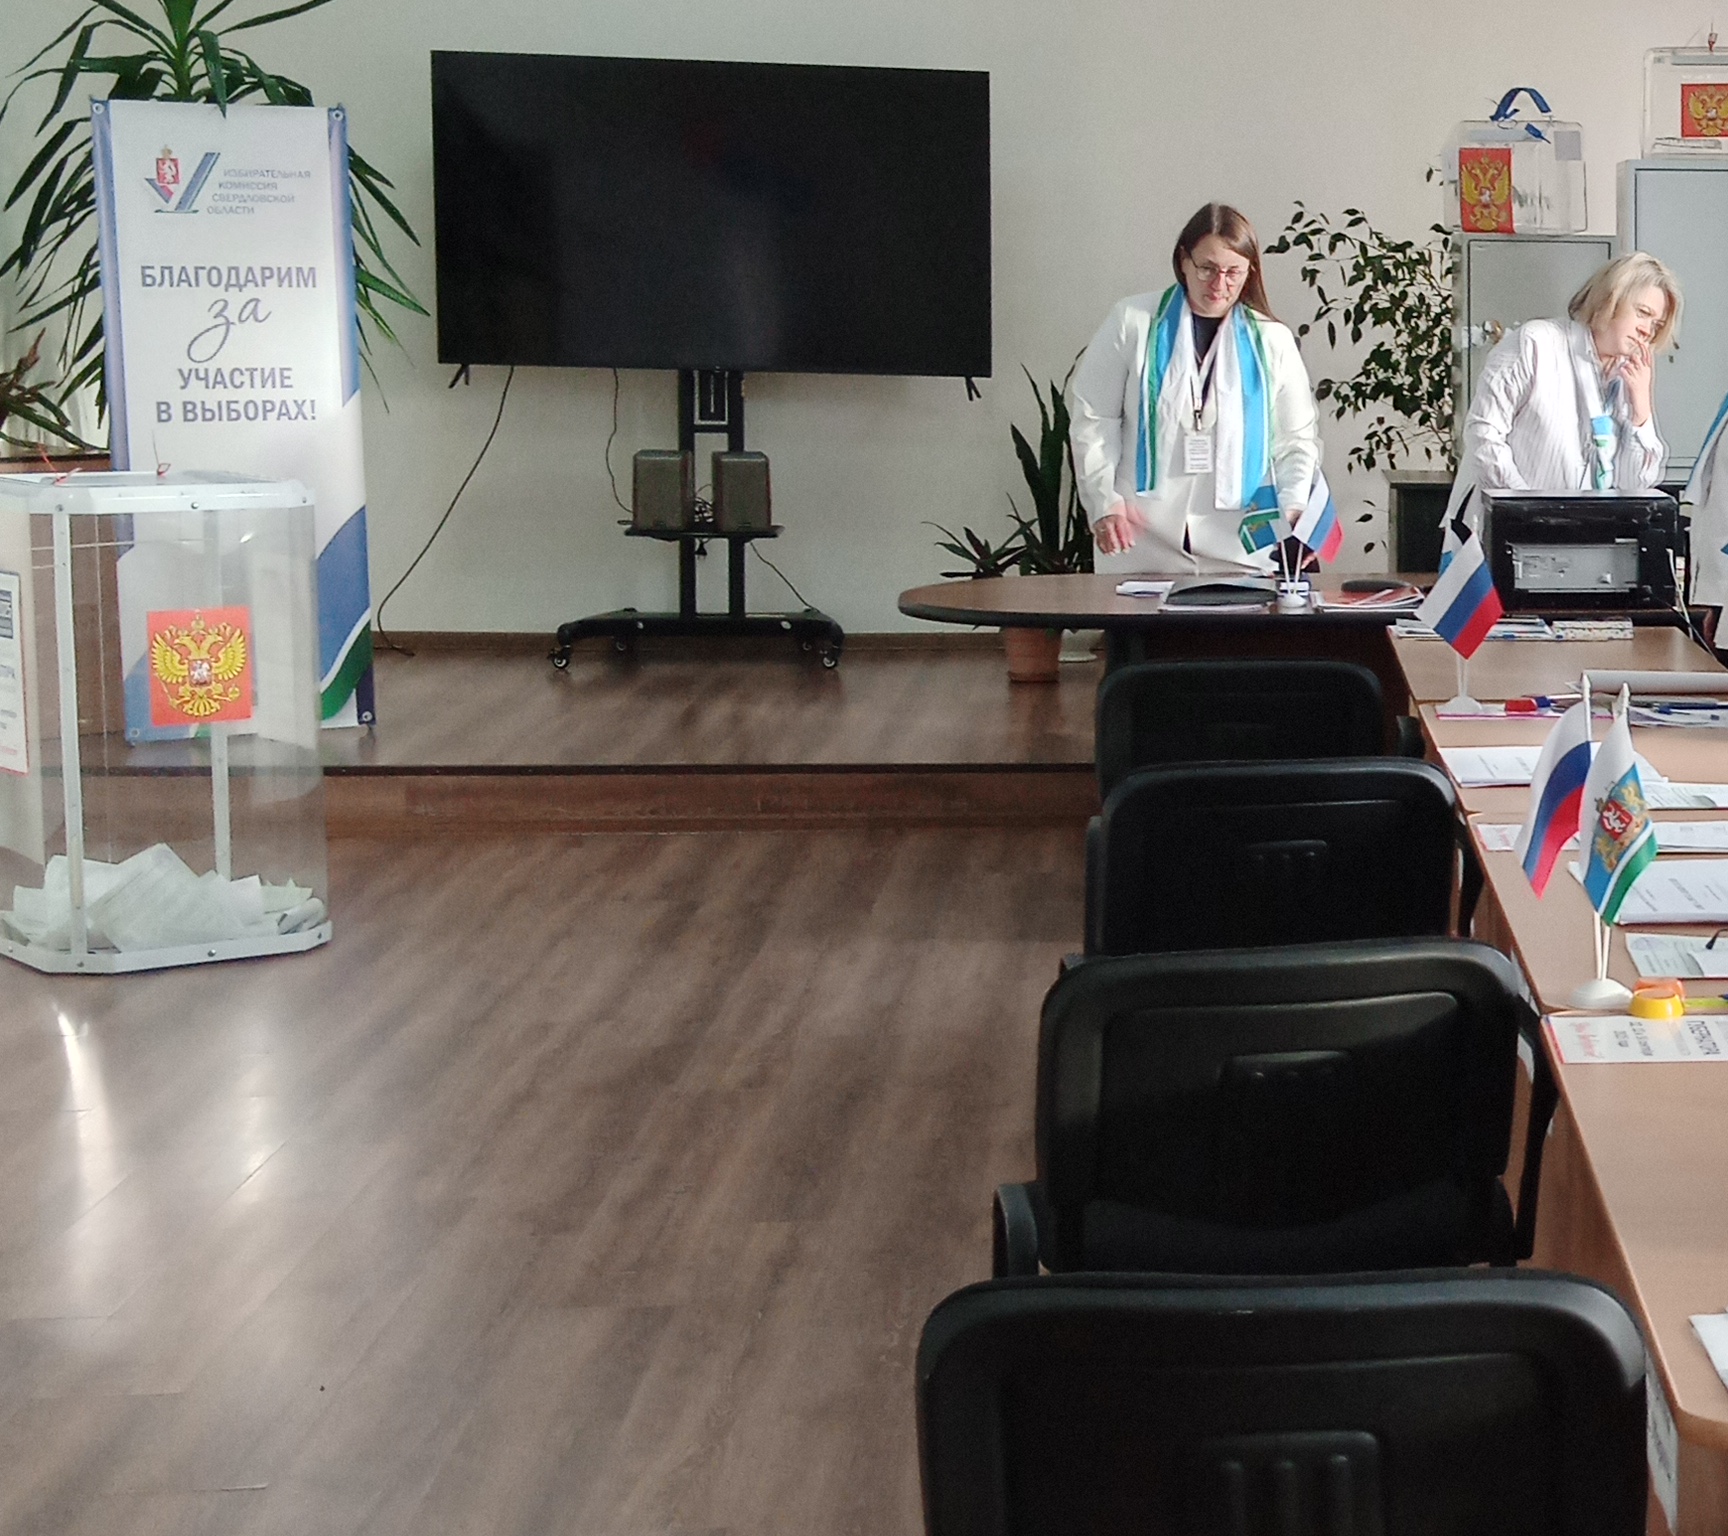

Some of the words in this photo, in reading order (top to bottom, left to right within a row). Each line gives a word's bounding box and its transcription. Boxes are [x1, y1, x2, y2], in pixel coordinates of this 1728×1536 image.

[223, 168, 311, 179] ИЗБИРАТЕЛЬНАЯ
[218, 181, 278, 191] КОМИССИЯ
[205, 205, 255, 215] ОБЛАСТИ
[140, 265, 317, 293] БЛАГОДАРИМ
[186, 297, 273, 364] за
[177, 367, 294, 390] УЧАСТИЕ
[155, 401, 173, 424] В
[182, 399, 317, 423] ВЫБОРАХ!
